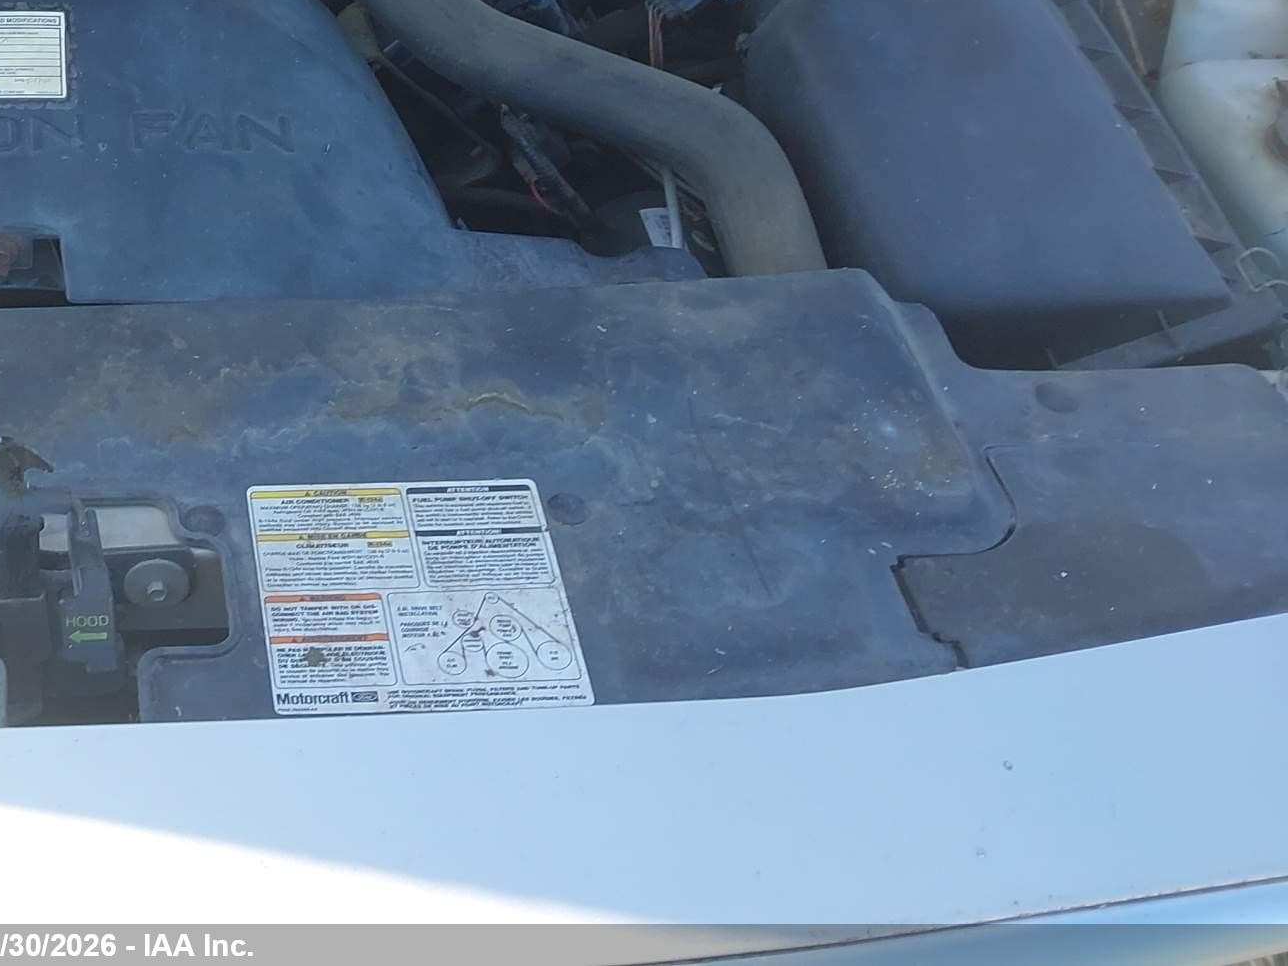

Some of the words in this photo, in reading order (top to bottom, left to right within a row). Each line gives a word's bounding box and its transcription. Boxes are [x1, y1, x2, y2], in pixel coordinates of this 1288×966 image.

[129, 113, 297, 154] FAN
[65, 614, 109, 626] HOOD
[276, 691, 349, 705] Motorcraft
